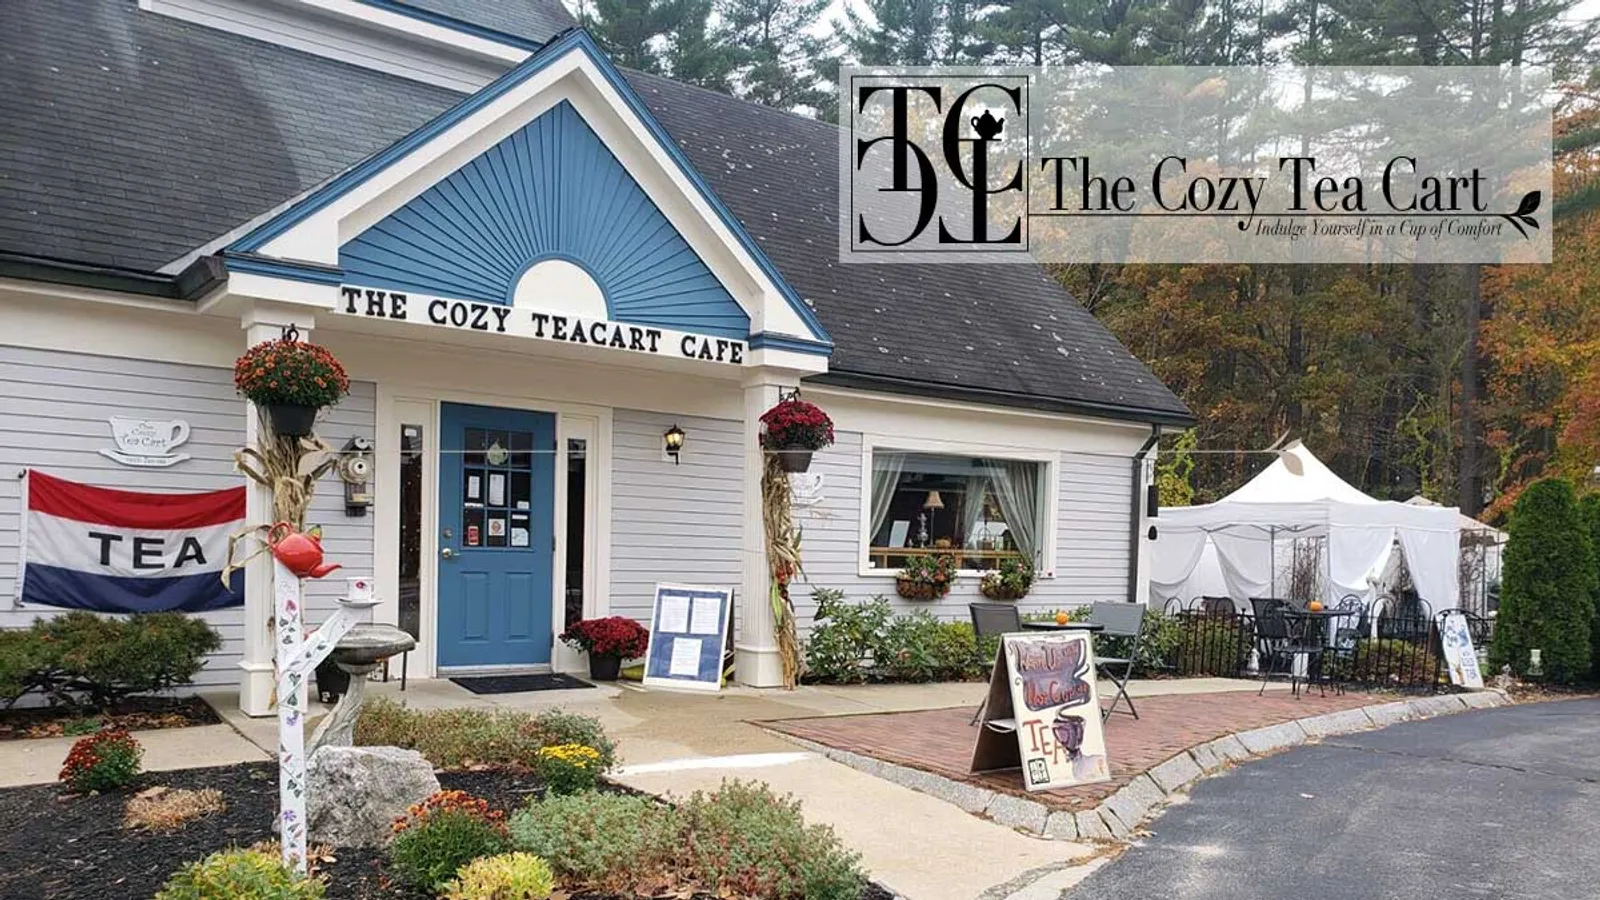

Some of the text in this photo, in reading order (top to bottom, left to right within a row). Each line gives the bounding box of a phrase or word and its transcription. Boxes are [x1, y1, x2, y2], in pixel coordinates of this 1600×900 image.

[341, 286, 743, 364] THE COZY TEACART CAFE
[88, 531, 207, 569] TEA
[1023, 719, 1069, 764] TEA
